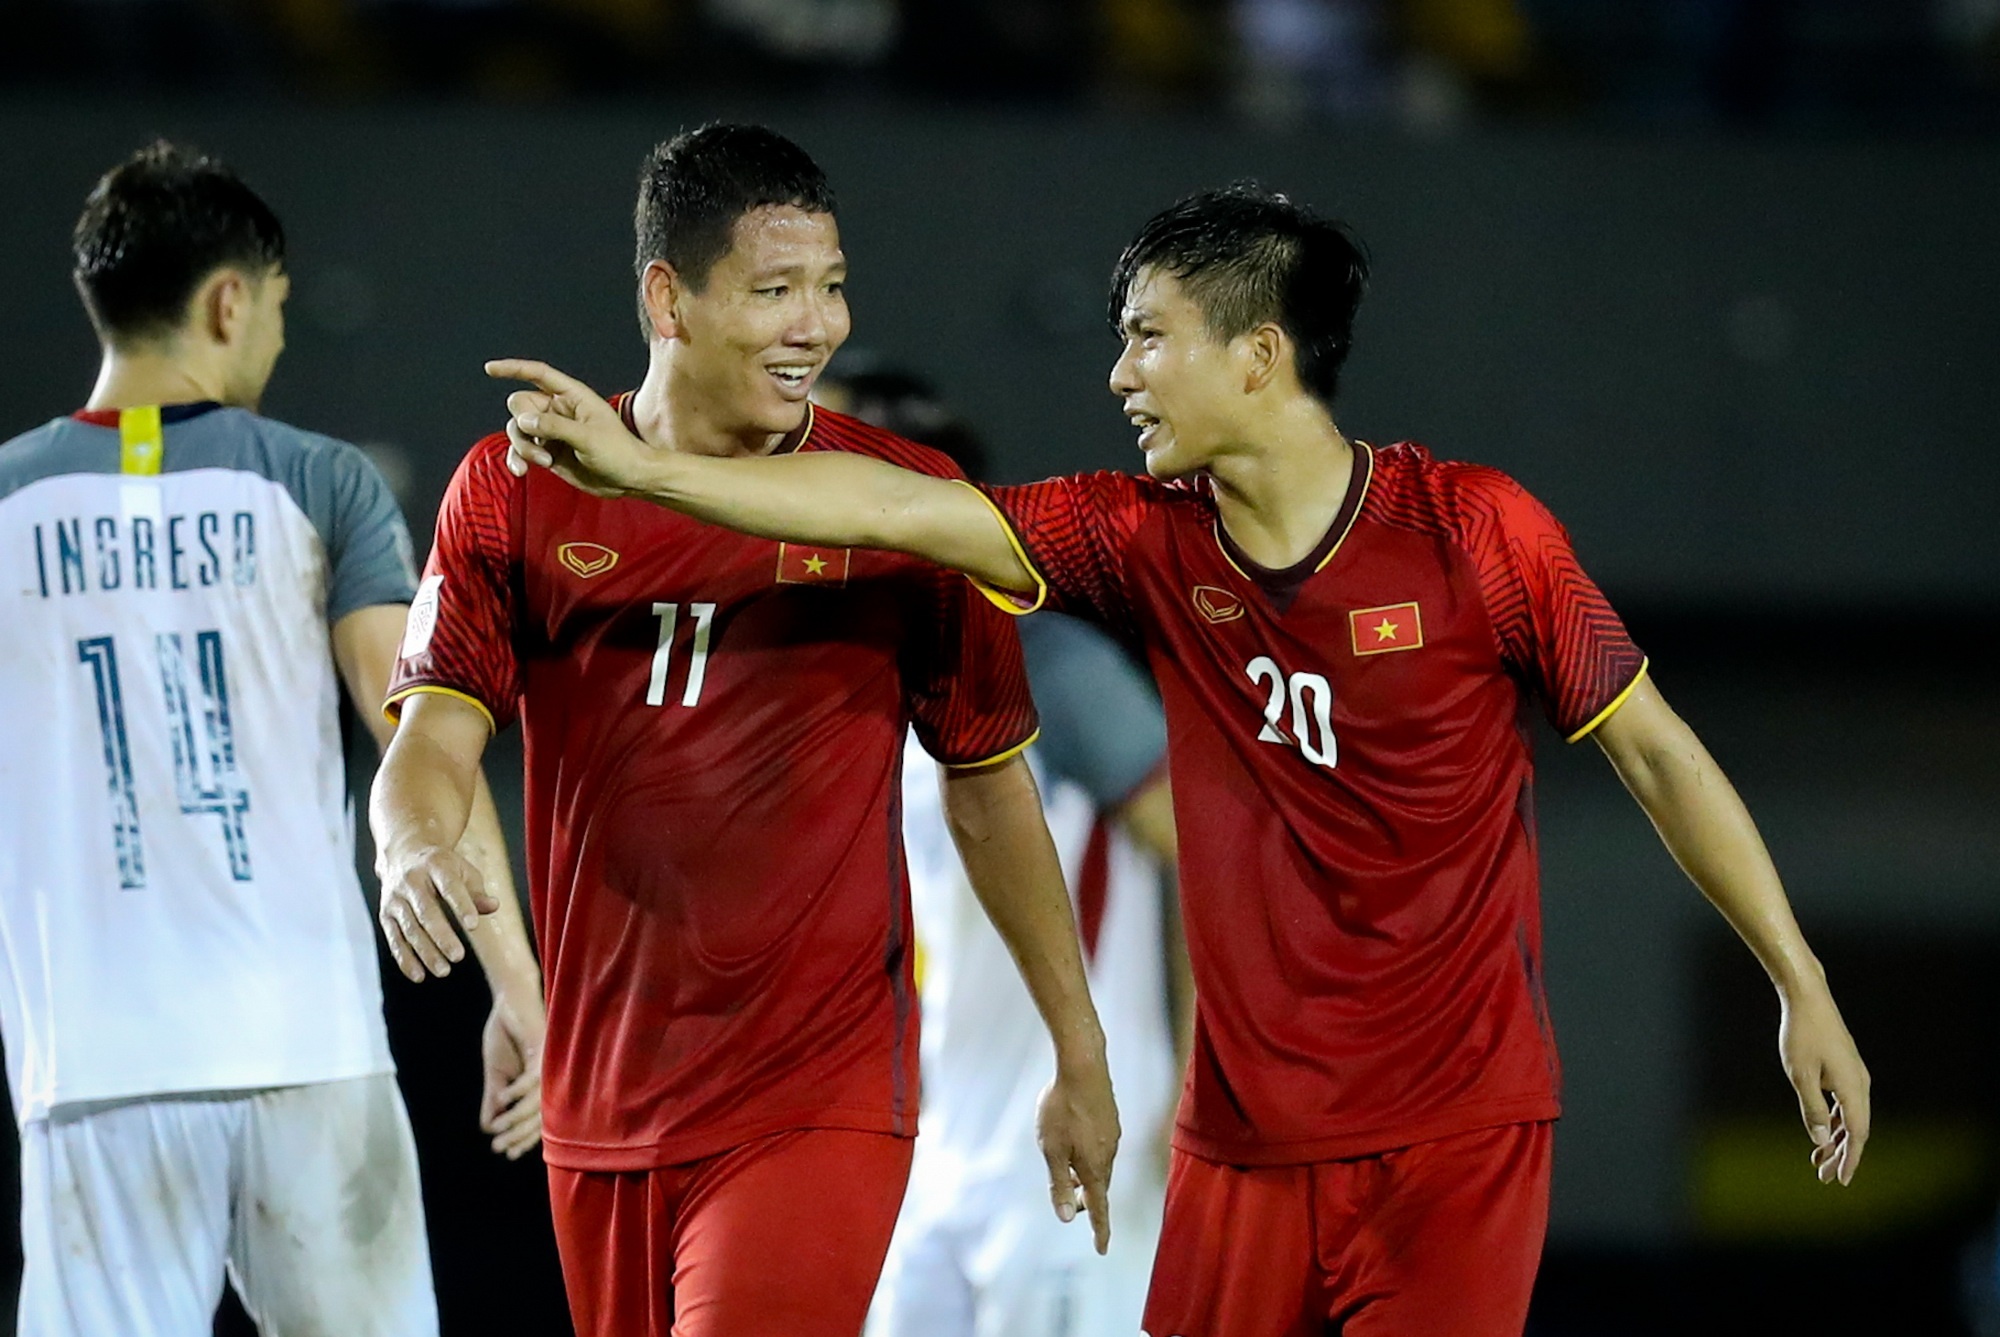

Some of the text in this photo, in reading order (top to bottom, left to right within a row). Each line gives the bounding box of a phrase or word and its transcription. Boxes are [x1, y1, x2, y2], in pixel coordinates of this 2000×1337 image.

[34, 511, 257, 598] INGRESO
[646, 602, 716, 707] 11
[77, 630, 252, 889] 14
[1246, 656, 1338, 769] 20
